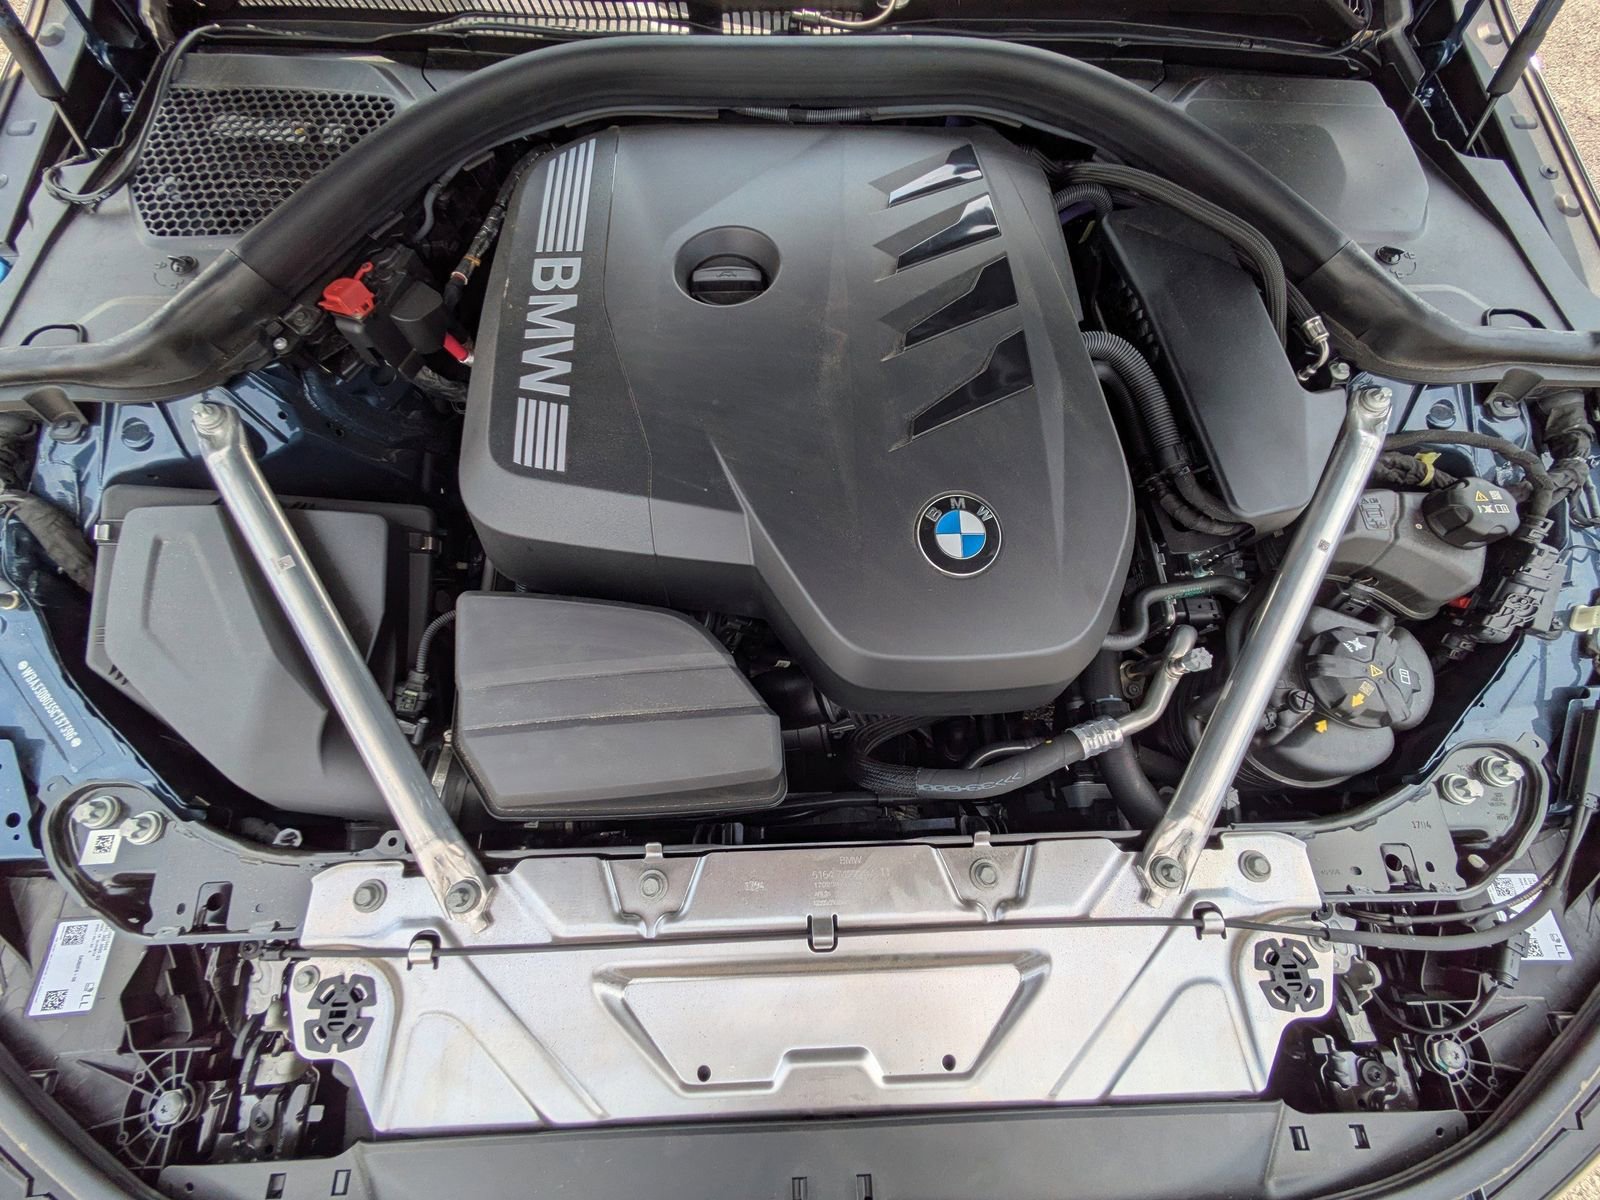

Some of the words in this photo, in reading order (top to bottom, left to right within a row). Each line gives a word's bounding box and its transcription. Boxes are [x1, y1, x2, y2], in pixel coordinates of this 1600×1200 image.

[519, 257, 582, 397] BMW
[925, 498, 993, 522] BMW
[839, 855, 863, 865] BMW
